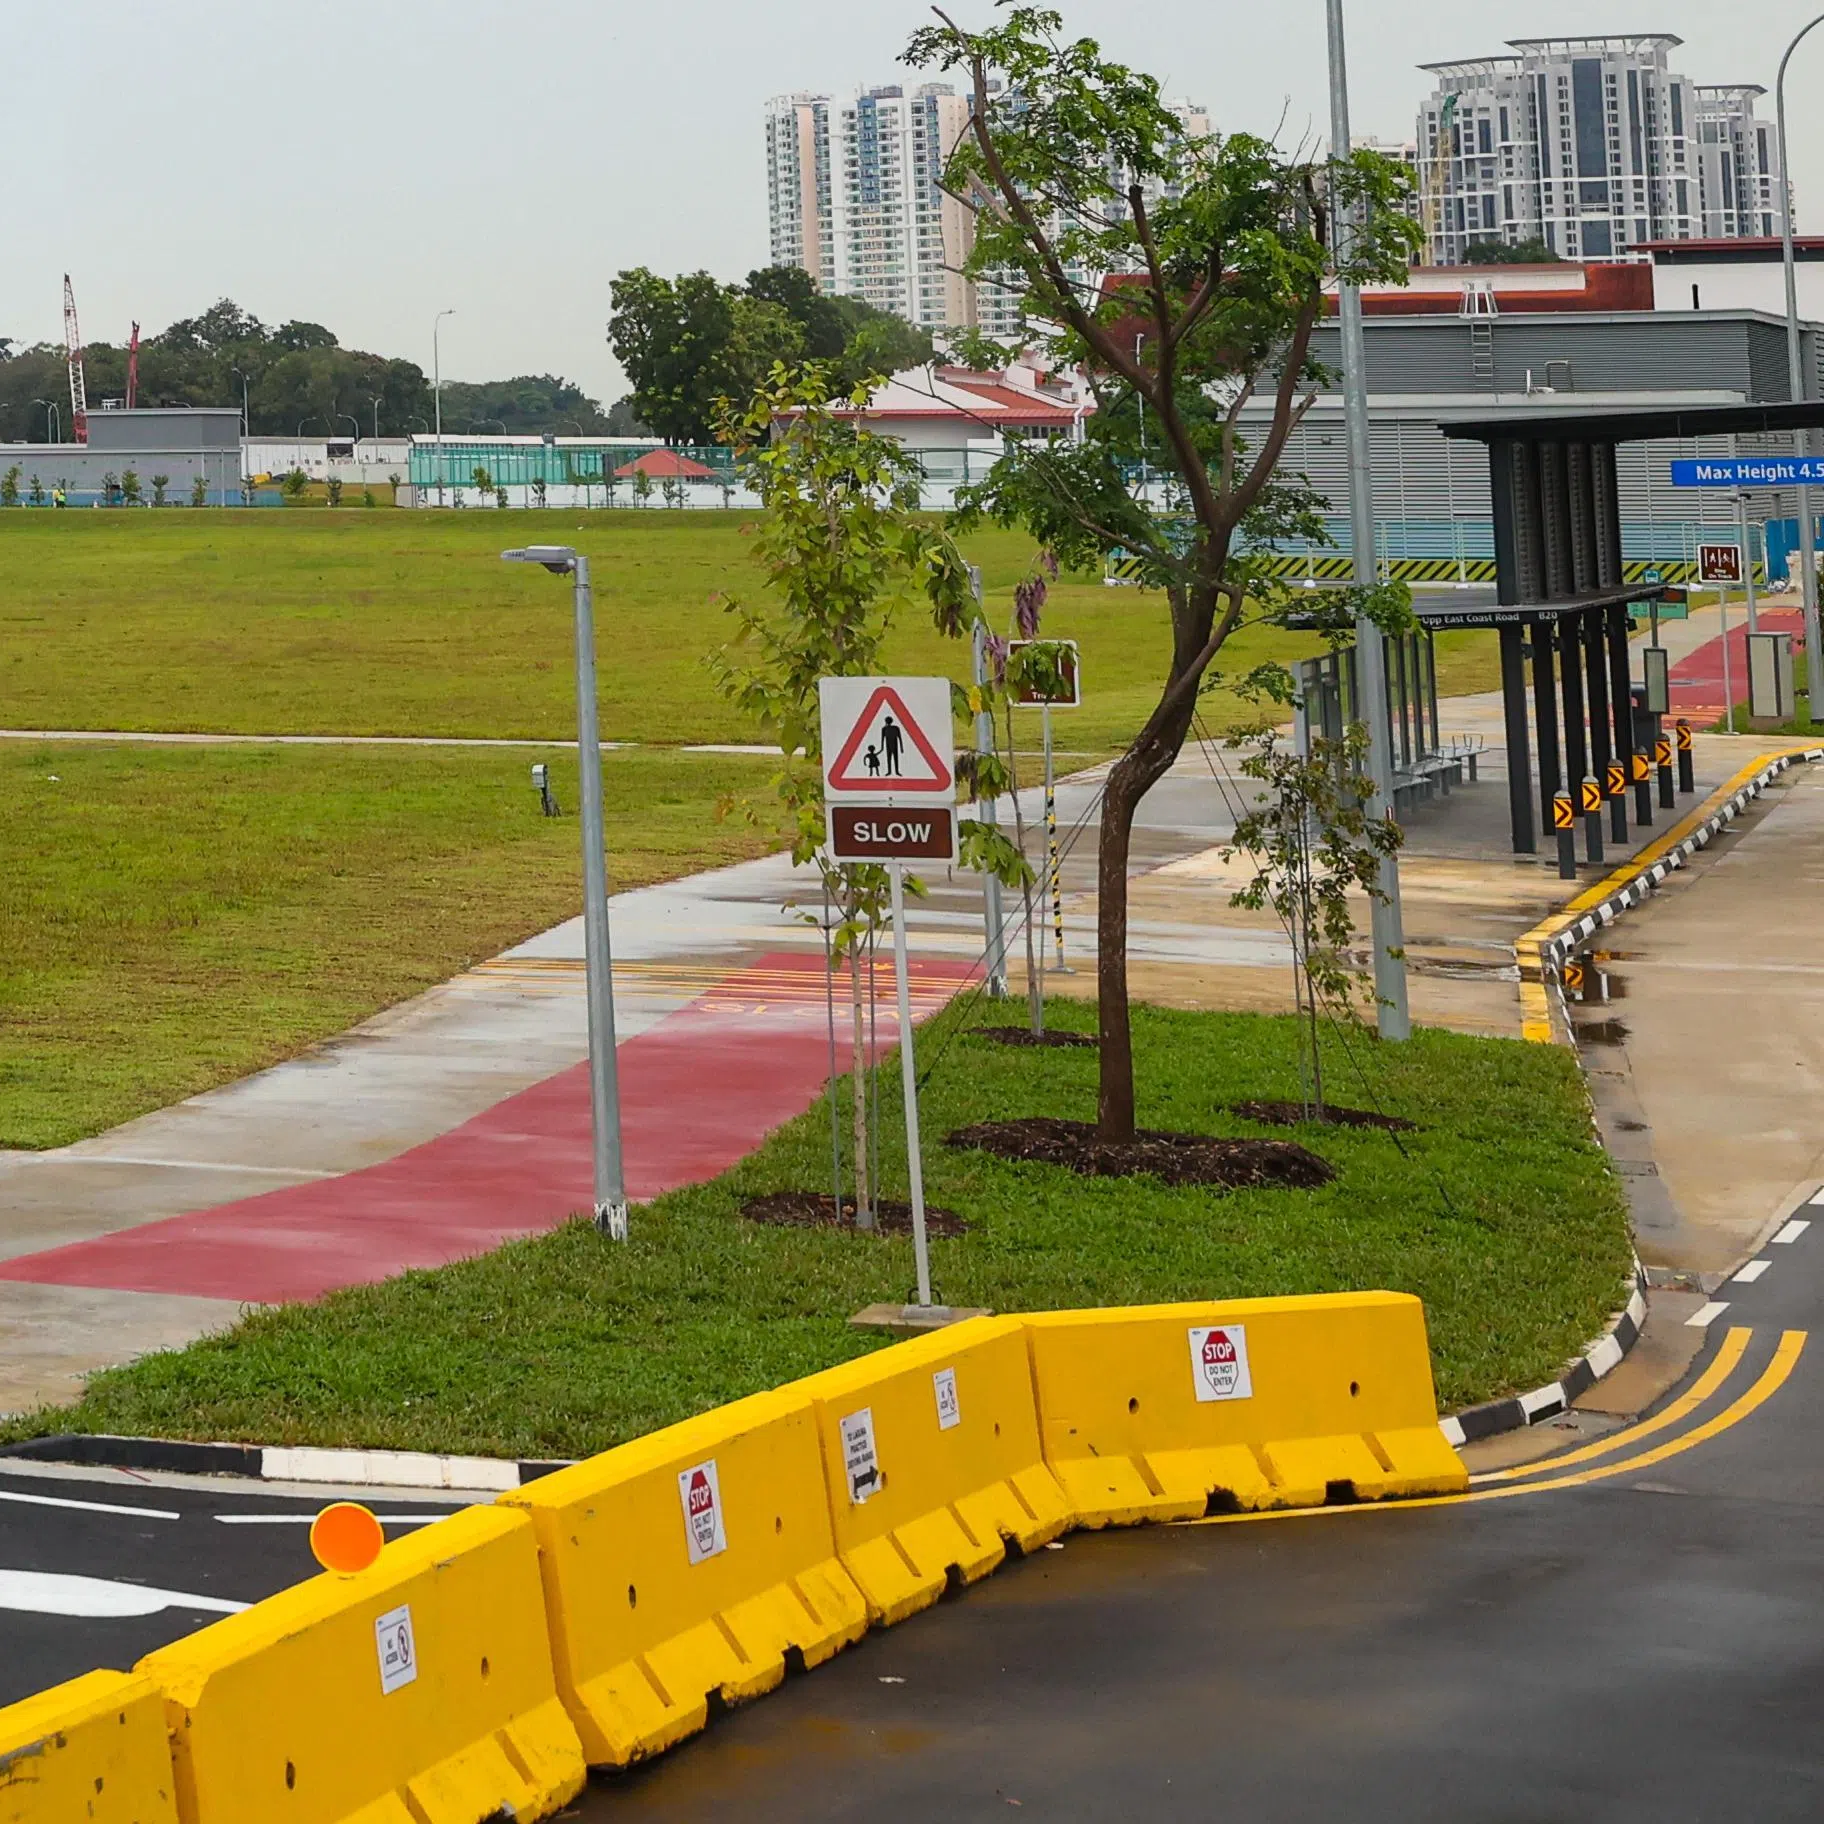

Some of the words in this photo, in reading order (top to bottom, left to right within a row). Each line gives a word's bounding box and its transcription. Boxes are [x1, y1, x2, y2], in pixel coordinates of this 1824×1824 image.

[1696, 465, 1732, 480] Max
[1737, 463, 1795, 482] Height
[1444, 615, 1464, 624] East
[1466, 613, 1493, 623] Coast
[1495, 612, 1520, 622] Road
[1538, 611, 1558, 620] B20
[853, 821, 931, 843] SLOW
[1204, 1342, 1232, 1360] STOP
[1209, 1366, 1218, 1376] DO
[1220, 1364, 1233, 1374] NOT
[1213, 1376, 1233, 1386] ENTER
[690, 1483, 710, 1510] STOP
